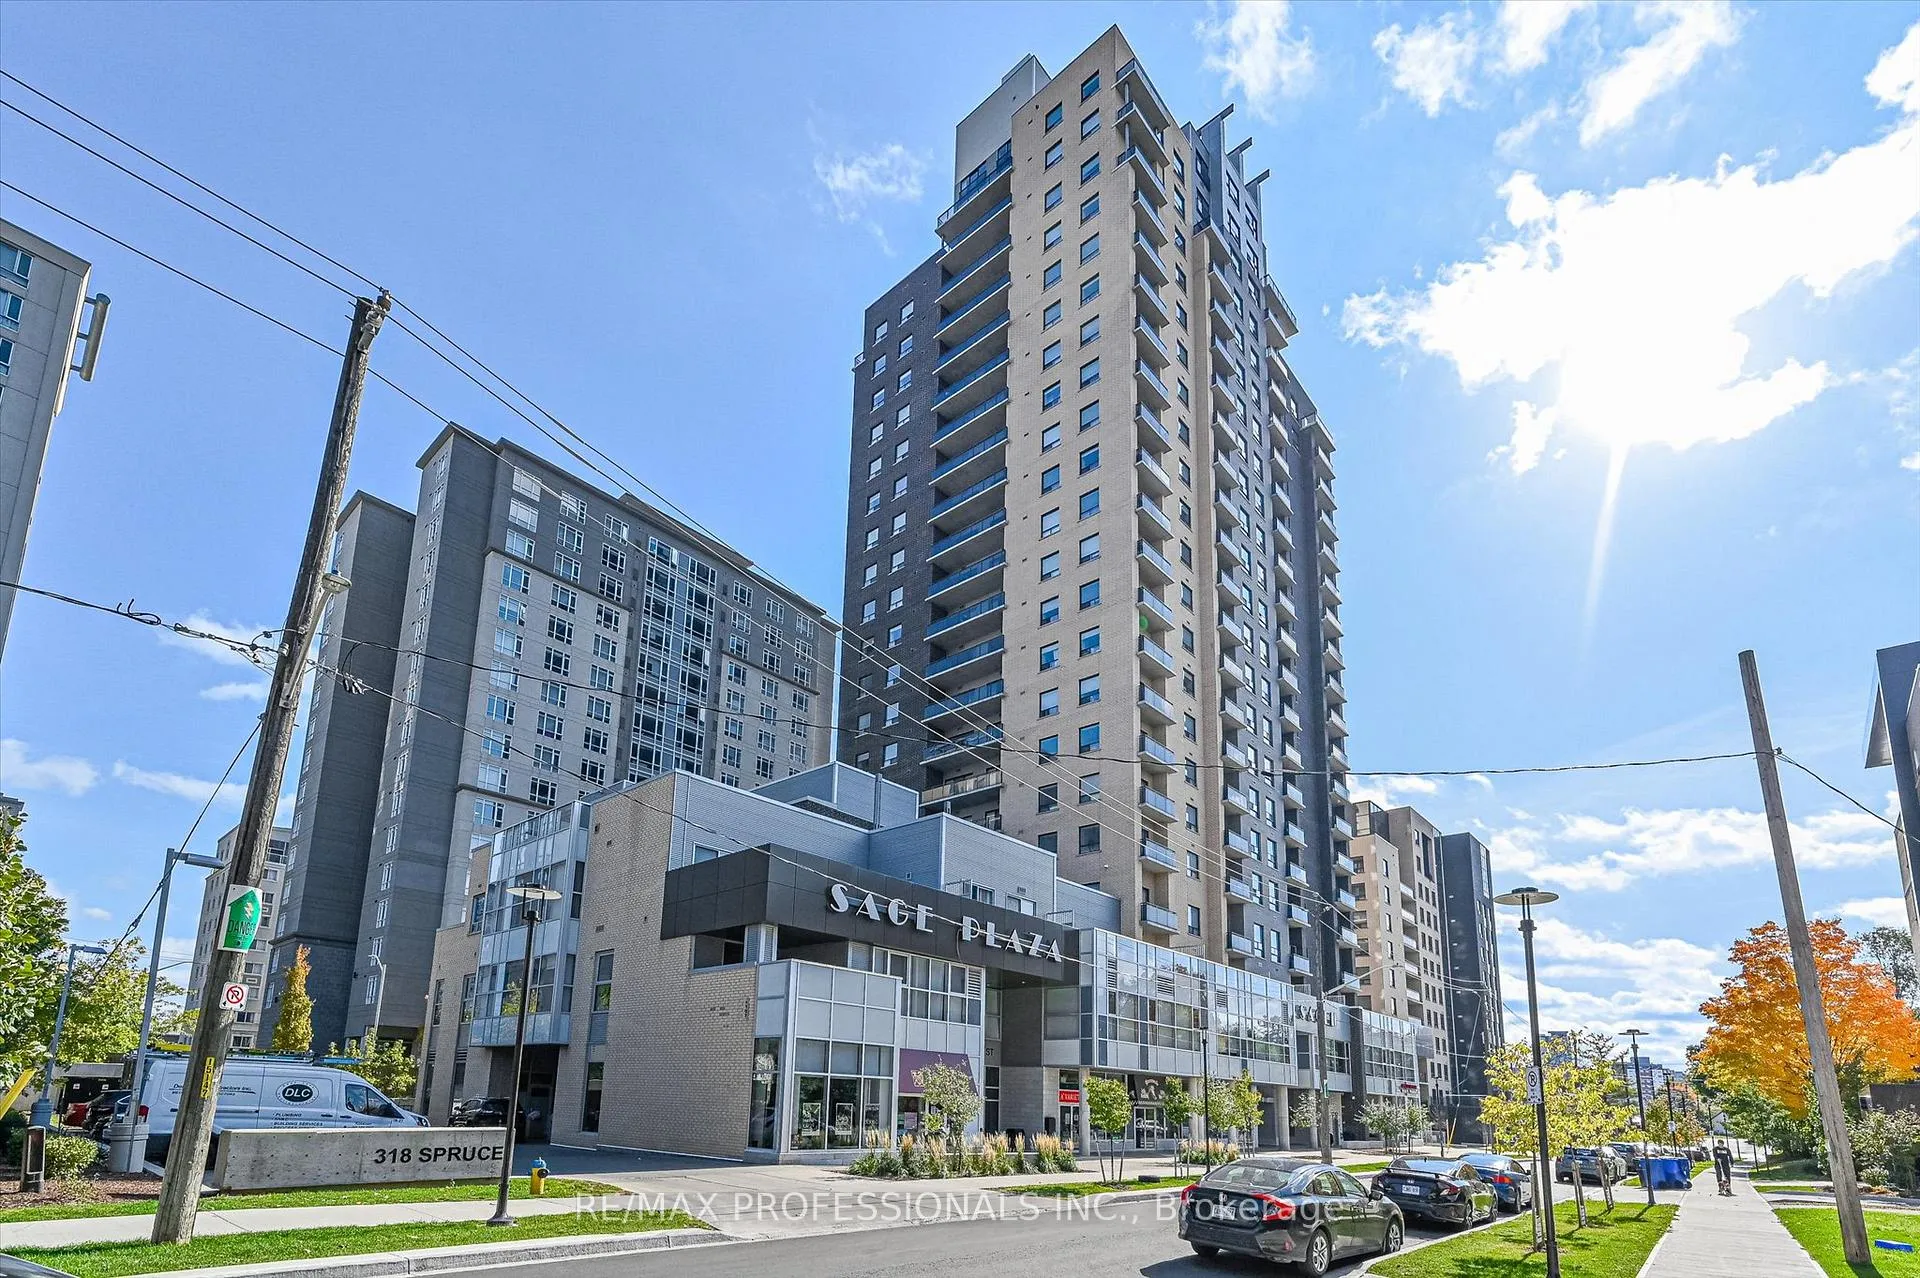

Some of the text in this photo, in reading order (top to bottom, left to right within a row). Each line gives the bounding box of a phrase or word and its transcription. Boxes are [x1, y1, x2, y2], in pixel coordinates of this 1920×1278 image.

[830, 883, 1062, 963] SAGE PLAZA
[284, 1088, 311, 1098] DLC
[374, 1146, 503, 1164] 318 SPRUCE
